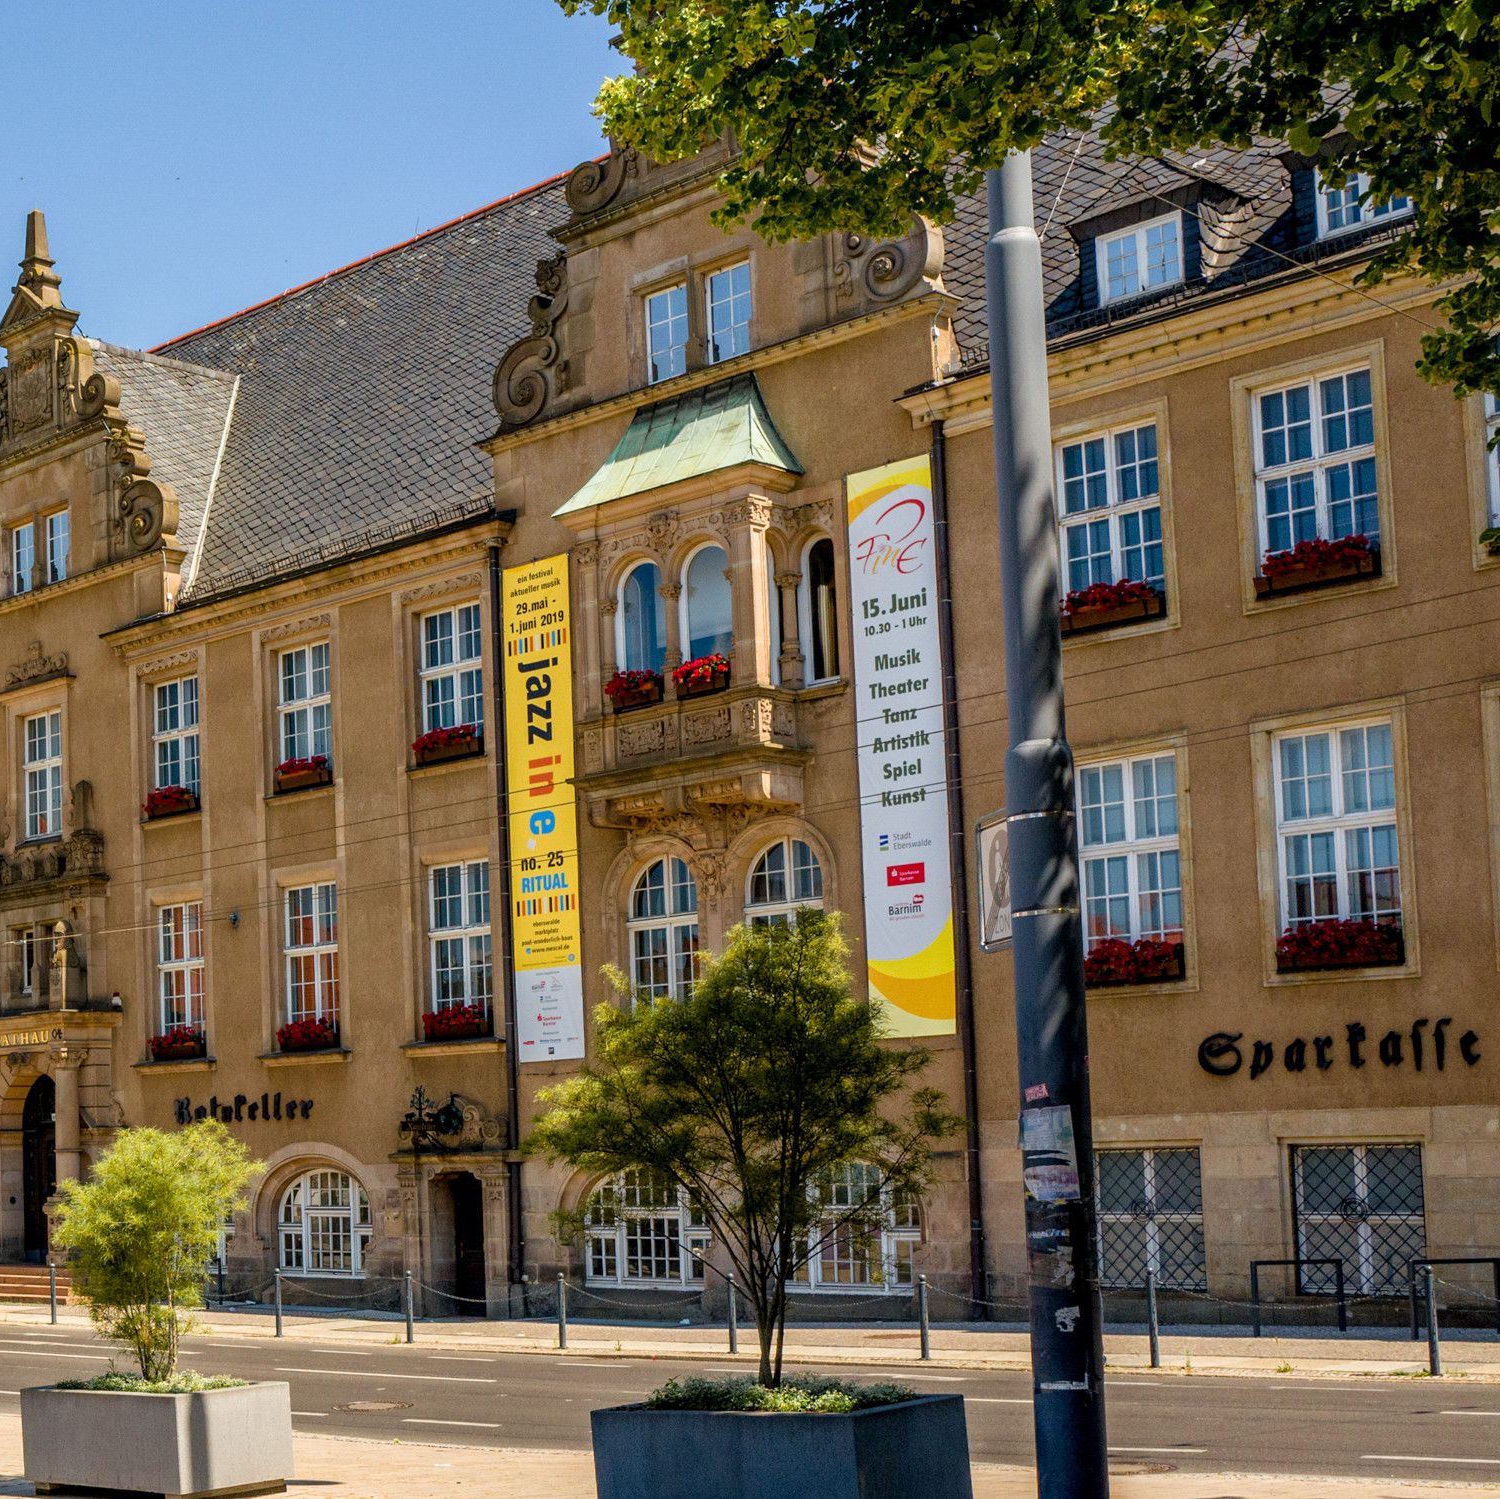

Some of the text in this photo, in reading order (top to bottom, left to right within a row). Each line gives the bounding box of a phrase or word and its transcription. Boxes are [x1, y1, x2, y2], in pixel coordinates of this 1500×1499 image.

[517, 567, 553, 584] ein festival
[510, 578, 560, 597] aktueller musik
[862, 587, 927, 619] 15. Juni
[541, 610, 564, 626] 2019
[864, 622, 891, 637] 10.30
[902, 619, 906, 629] 1
[909, 616, 927, 627] Uhr
[875, 648, 921, 671] Musik
[869, 678, 929, 699] Theater
[518, 656, 558, 745] jazz
[883, 708, 917, 724] Tanz
[873, 730, 930, 754] Artistik
[529, 755, 561, 797] in
[883, 759, 922, 781] Spiel
[881, 788, 926, 807] Kunst
[893, 832, 911, 841] Stadt
[893, 839, 932, 850] Eberswalde
[521, 851, 564, 871] no. 25
[521, 872, 568, 893] RITUAL
[888, 904, 922, 916] Barnim
[533, 918, 560, 927] eberswalde
[995, 912, 1012, 934] ZON
